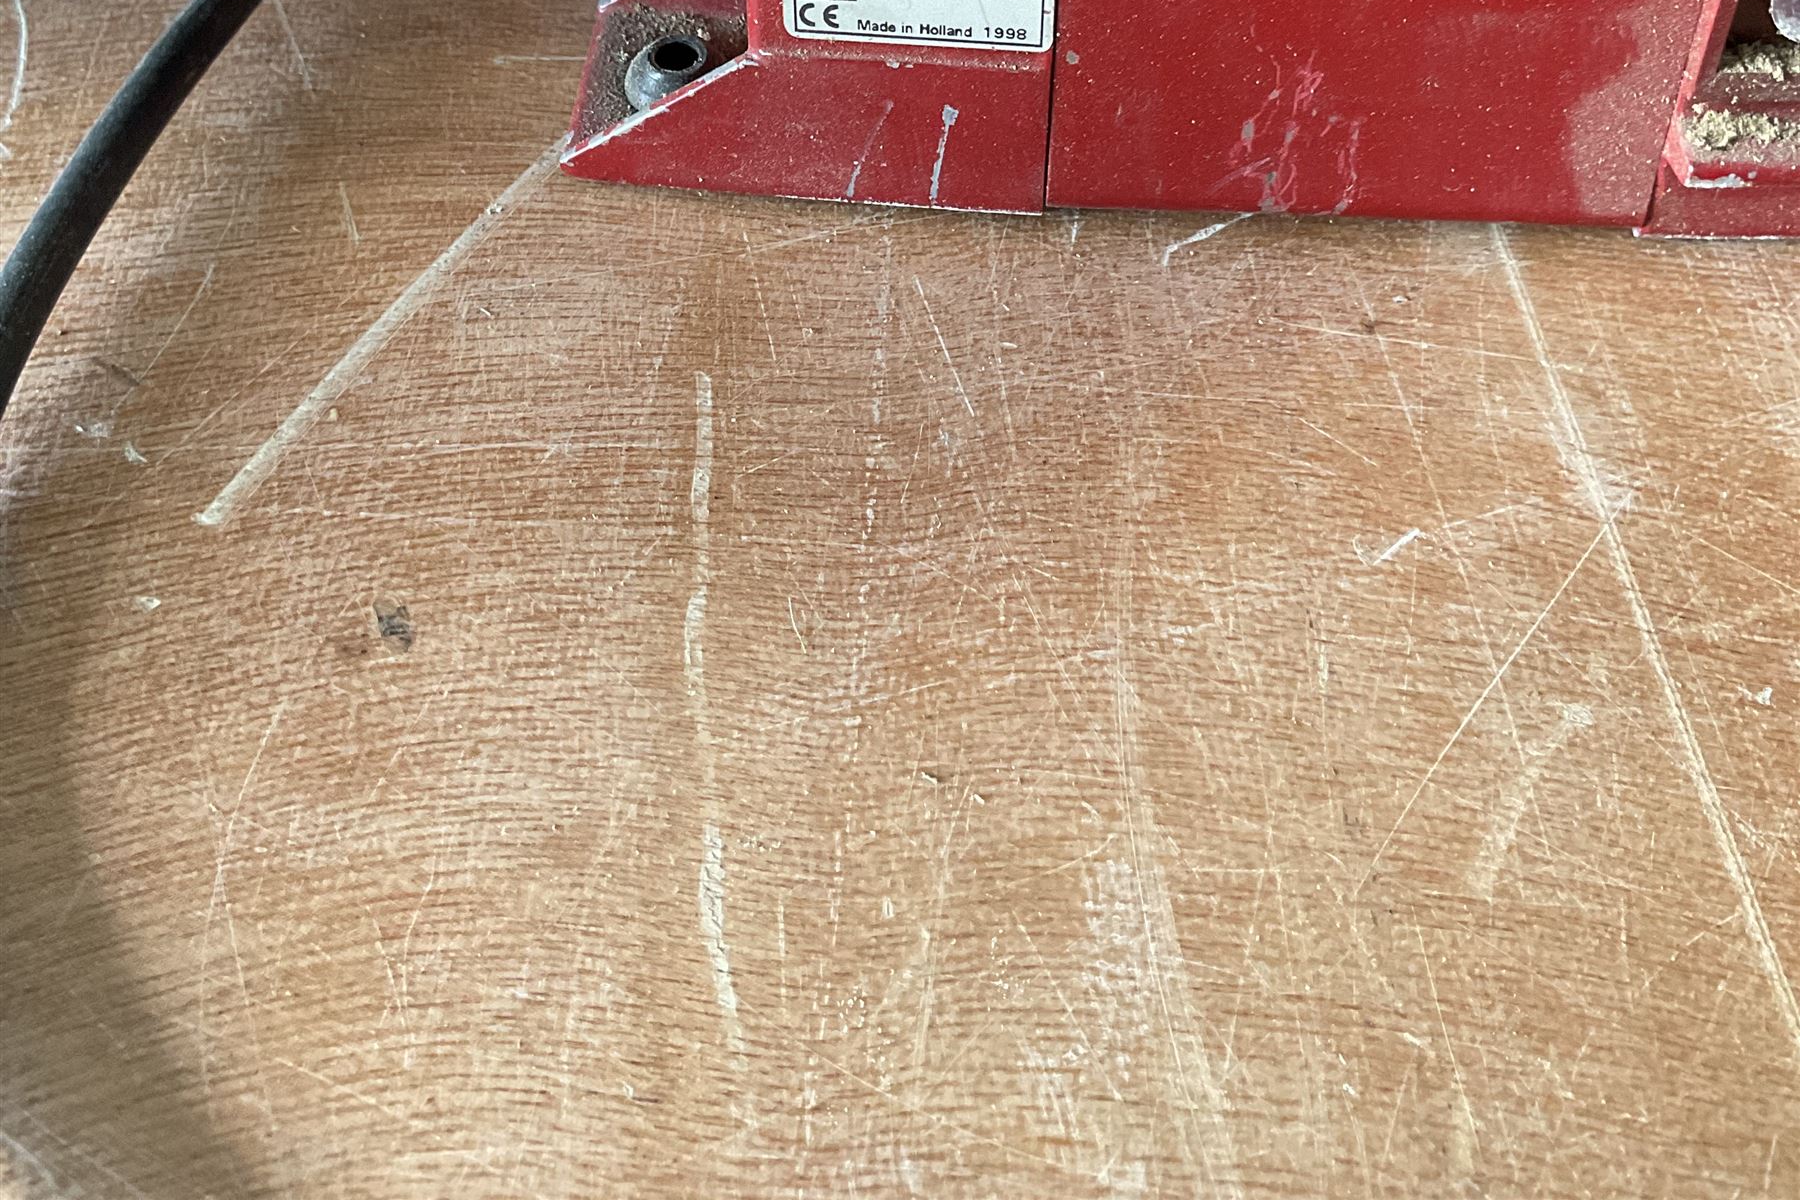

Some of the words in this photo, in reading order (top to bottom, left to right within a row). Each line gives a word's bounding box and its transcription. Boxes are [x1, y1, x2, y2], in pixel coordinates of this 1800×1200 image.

[857, 20, 895, 32] Made
[901, 22, 912, 34] in
[920, 23, 972, 38] Holland
[984, 27, 1026, 40] 1998
